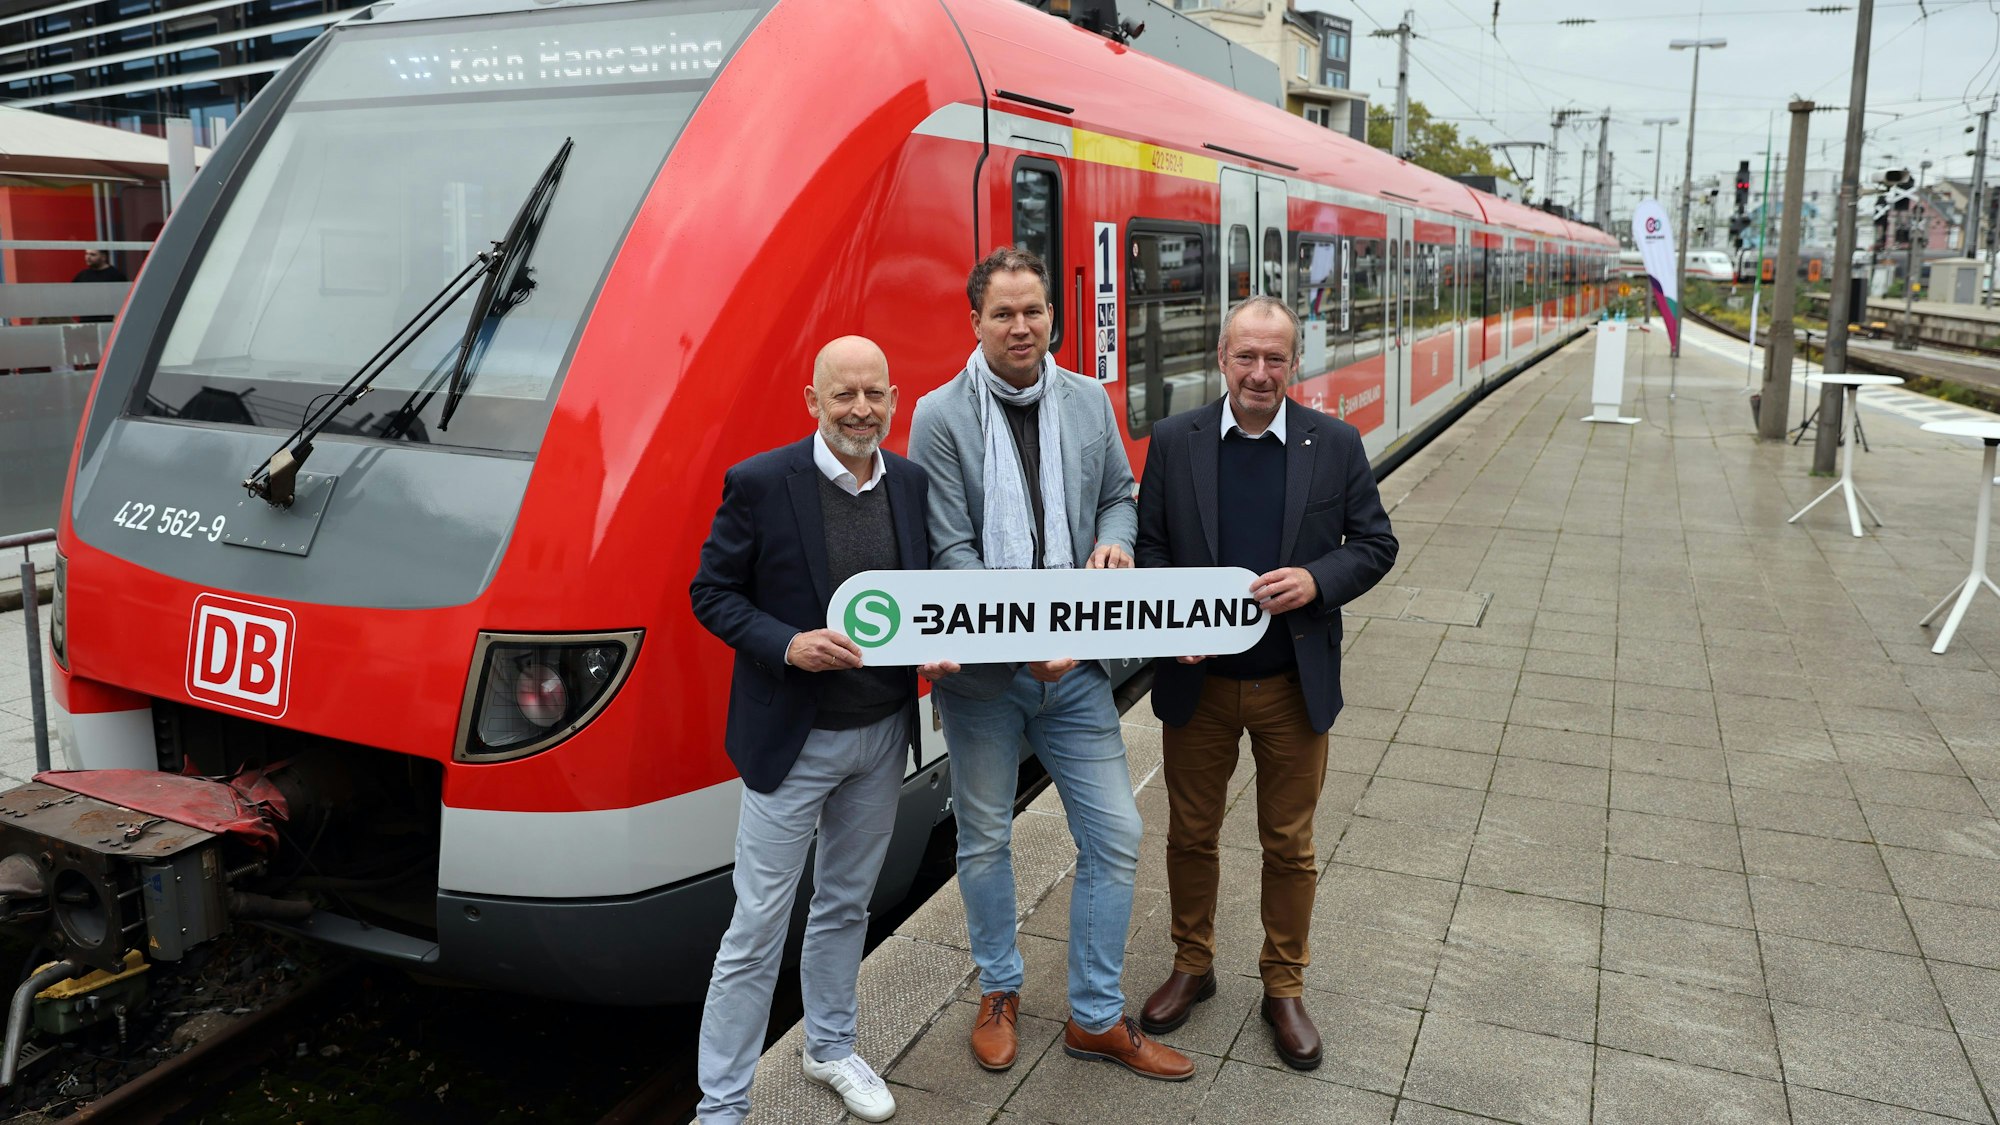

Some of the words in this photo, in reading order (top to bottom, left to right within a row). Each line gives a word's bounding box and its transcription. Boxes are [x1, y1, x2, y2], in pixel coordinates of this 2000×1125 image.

[1098, 226, 1114, 294] 1
[113, 500, 155, 532] 422
[157, 507, 226, 542] 562-9
[1049, 598, 1263, 632] RHEINLAND
[198, 611, 279, 697] DB
